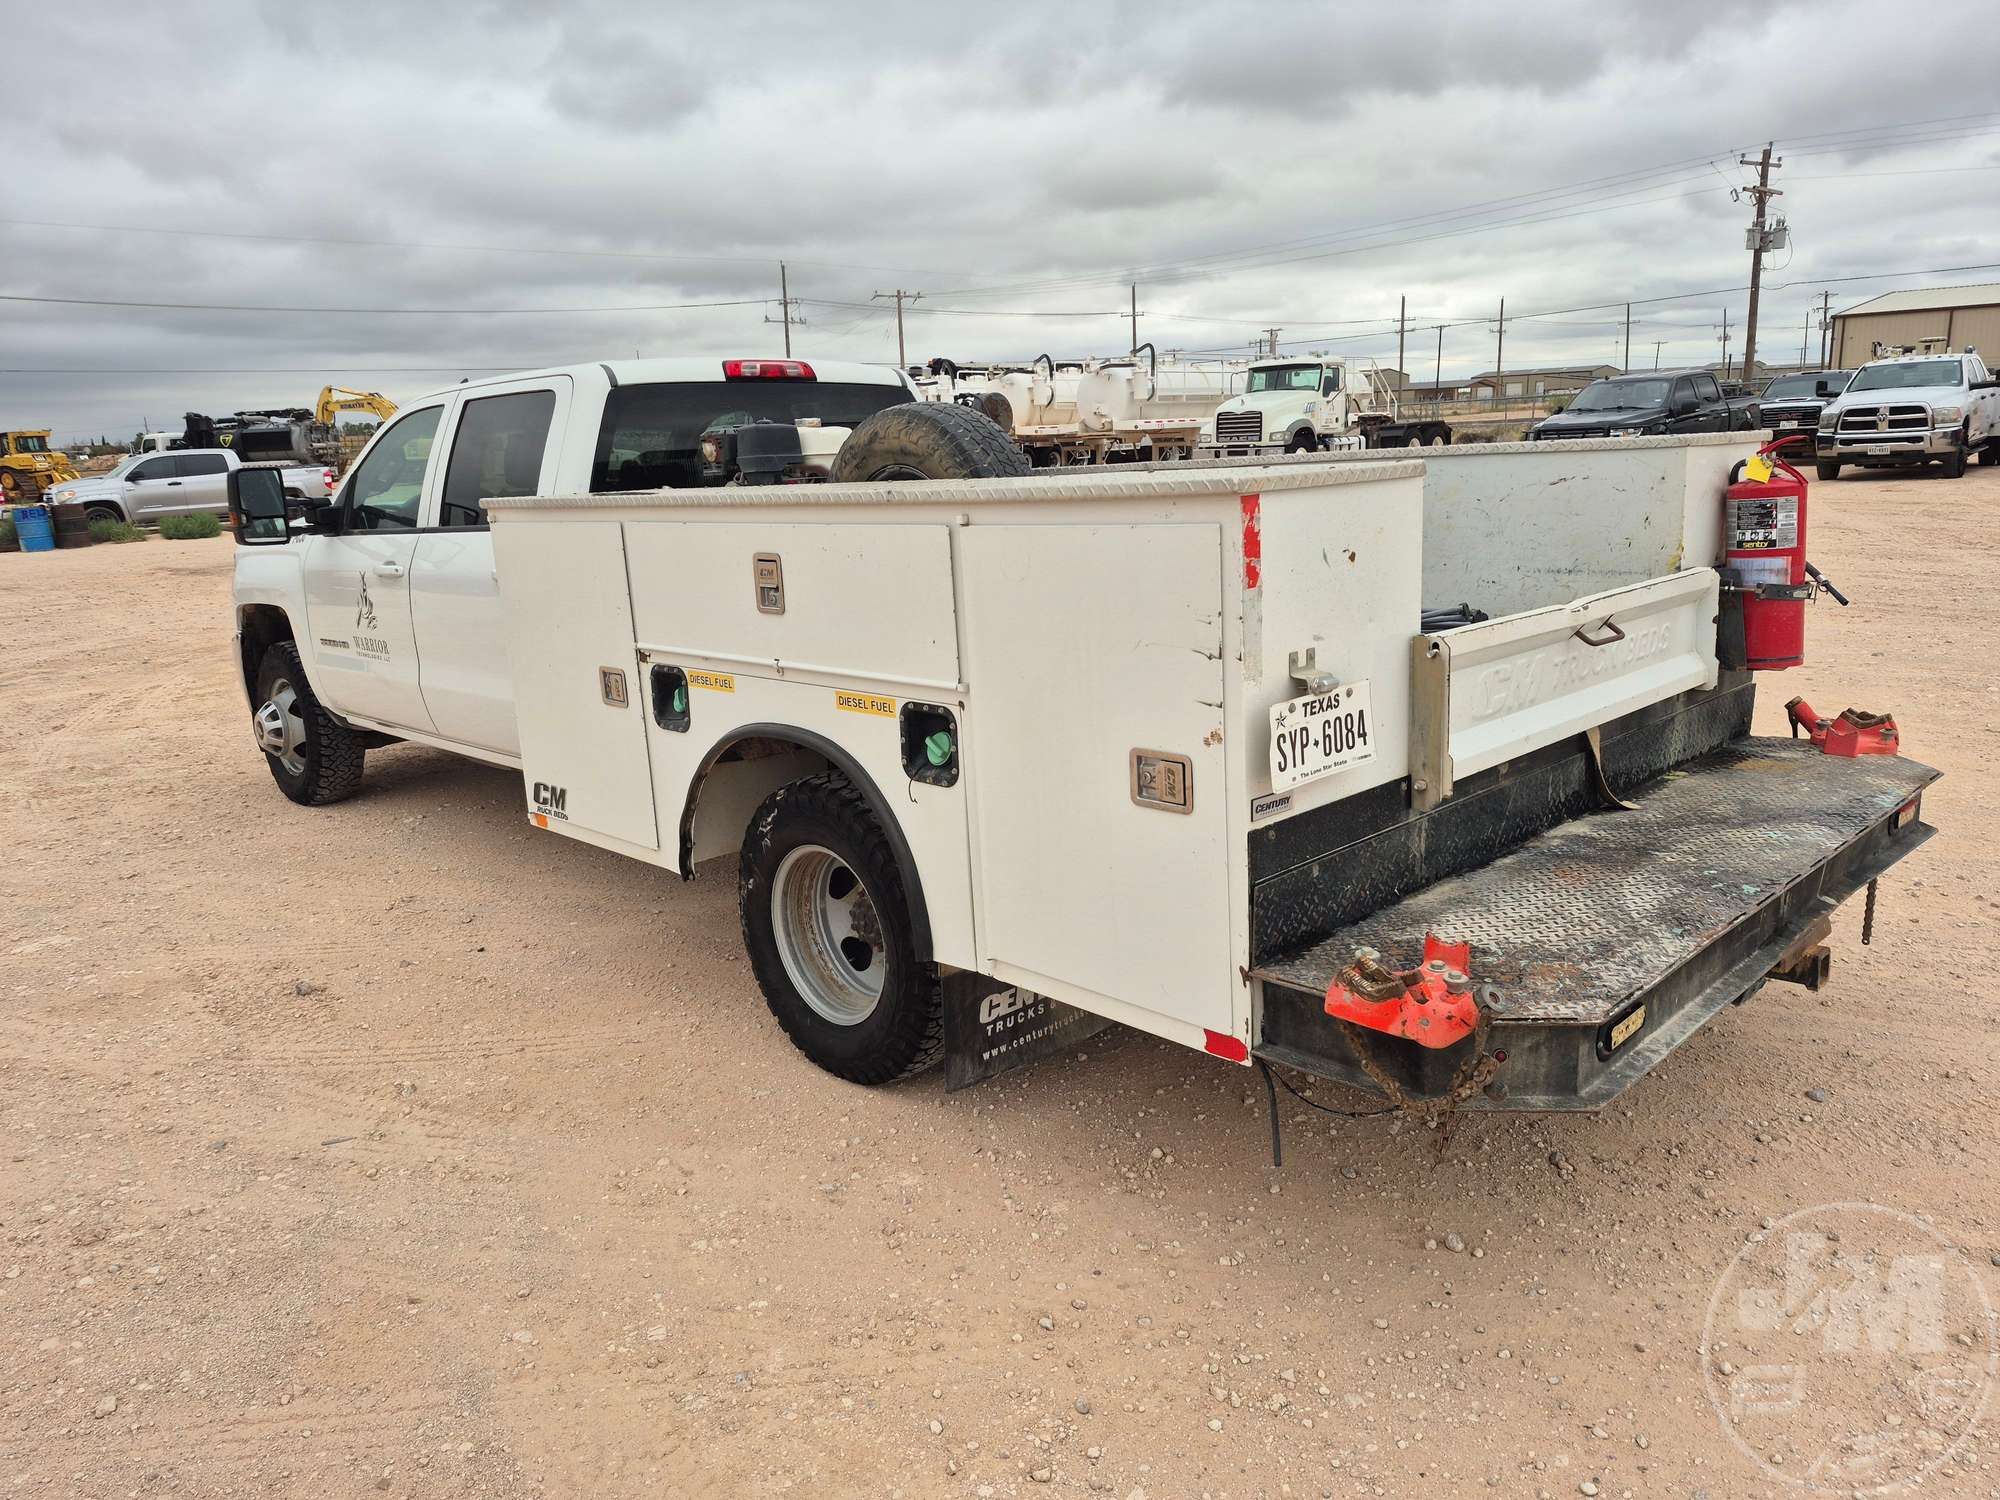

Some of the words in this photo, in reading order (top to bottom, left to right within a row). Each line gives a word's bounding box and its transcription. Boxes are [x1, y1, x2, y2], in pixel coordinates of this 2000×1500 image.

[1743, 540, 1769, 549] sentry
[353, 636, 389, 655] WARRIOR
[689, 674, 714, 687] DIESEL
[715, 677, 733, 690] FUEL
[838, 695, 869, 710] DIESEL
[871, 700, 894, 714] FUEL
[1302, 693, 1340, 717] TEXAS
[1276, 726, 1310, 772] SYP
[1322, 709, 1368, 757] 6084
[533, 782, 567, 810] CM
[1255, 795, 1291, 813] CENTURY
[554, 811, 569, 820] BEDS
[986, 1003, 1045, 1037] TRUCKS
